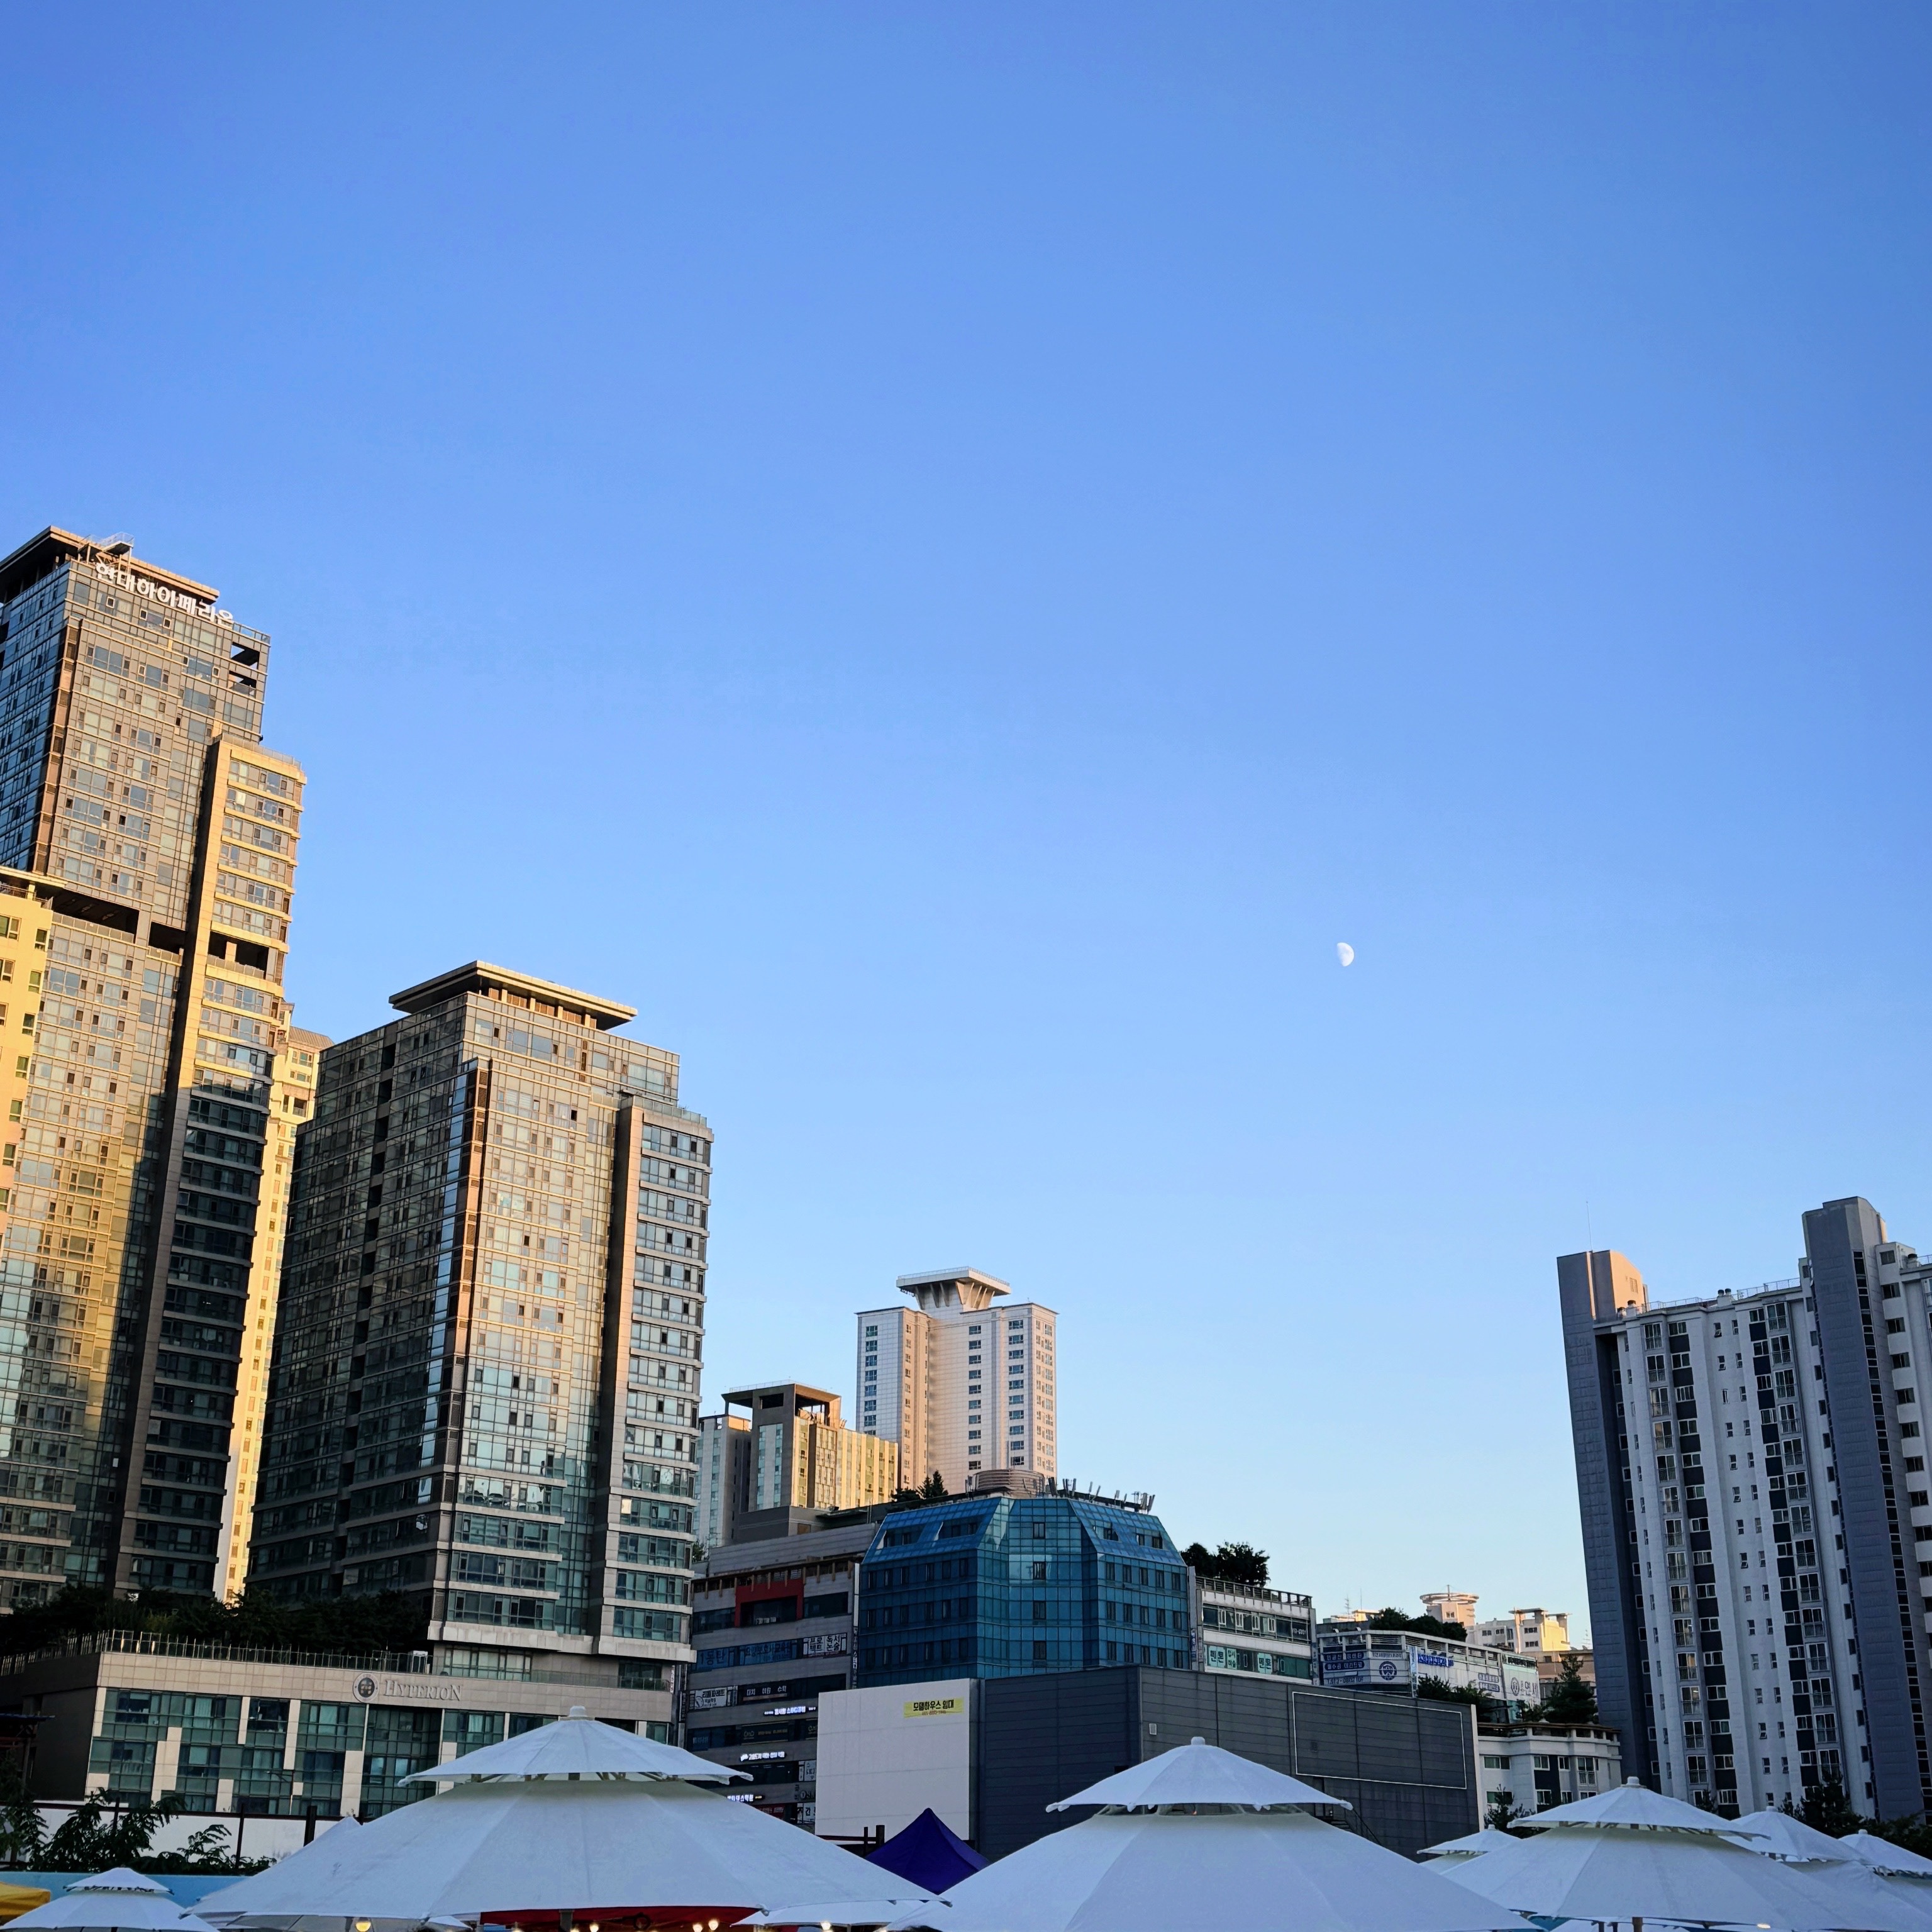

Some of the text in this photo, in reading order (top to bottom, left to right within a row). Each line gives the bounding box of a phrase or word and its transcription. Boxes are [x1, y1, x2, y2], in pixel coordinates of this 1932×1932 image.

[96, 562, 234, 630] 현대하이페리온
[384, 1680, 463, 1701] HYPERION
[913, 1699, 954, 1711] 모델하우스 임대
